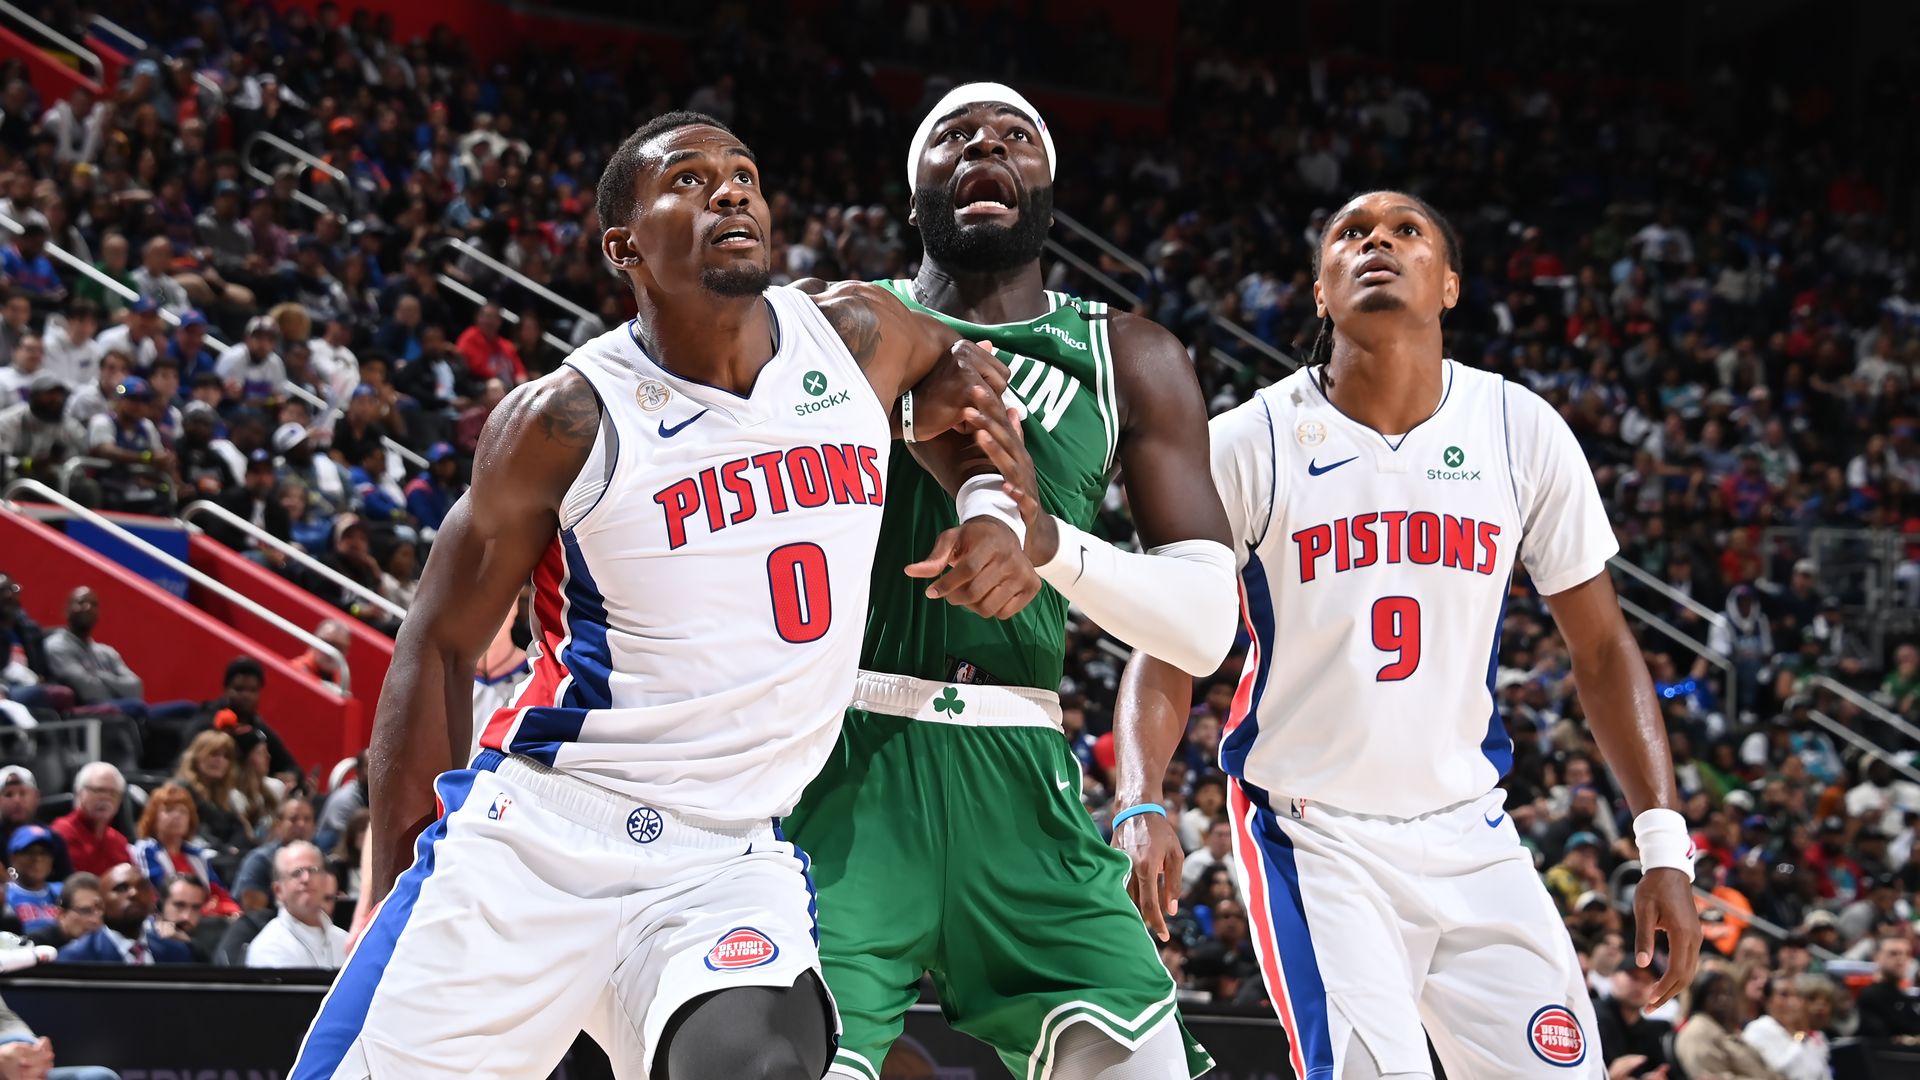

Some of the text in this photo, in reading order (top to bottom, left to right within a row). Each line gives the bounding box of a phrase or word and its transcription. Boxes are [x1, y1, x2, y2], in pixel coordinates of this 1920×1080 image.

[1033, 323, 1087, 351] Amica
[794, 388, 851, 416] StockX
[1426, 469, 1481, 480] StockX
[652, 443, 884, 550] PISTONS
[1291, 510, 1501, 584] PISTONS
[766, 541, 832, 644] 0
[1371, 595, 1421, 682] 9
[718, 948, 764, 959] PISTONS
[719, 941, 764, 952] DETROIT
[1541, 1035, 1579, 1049] PISTONS
